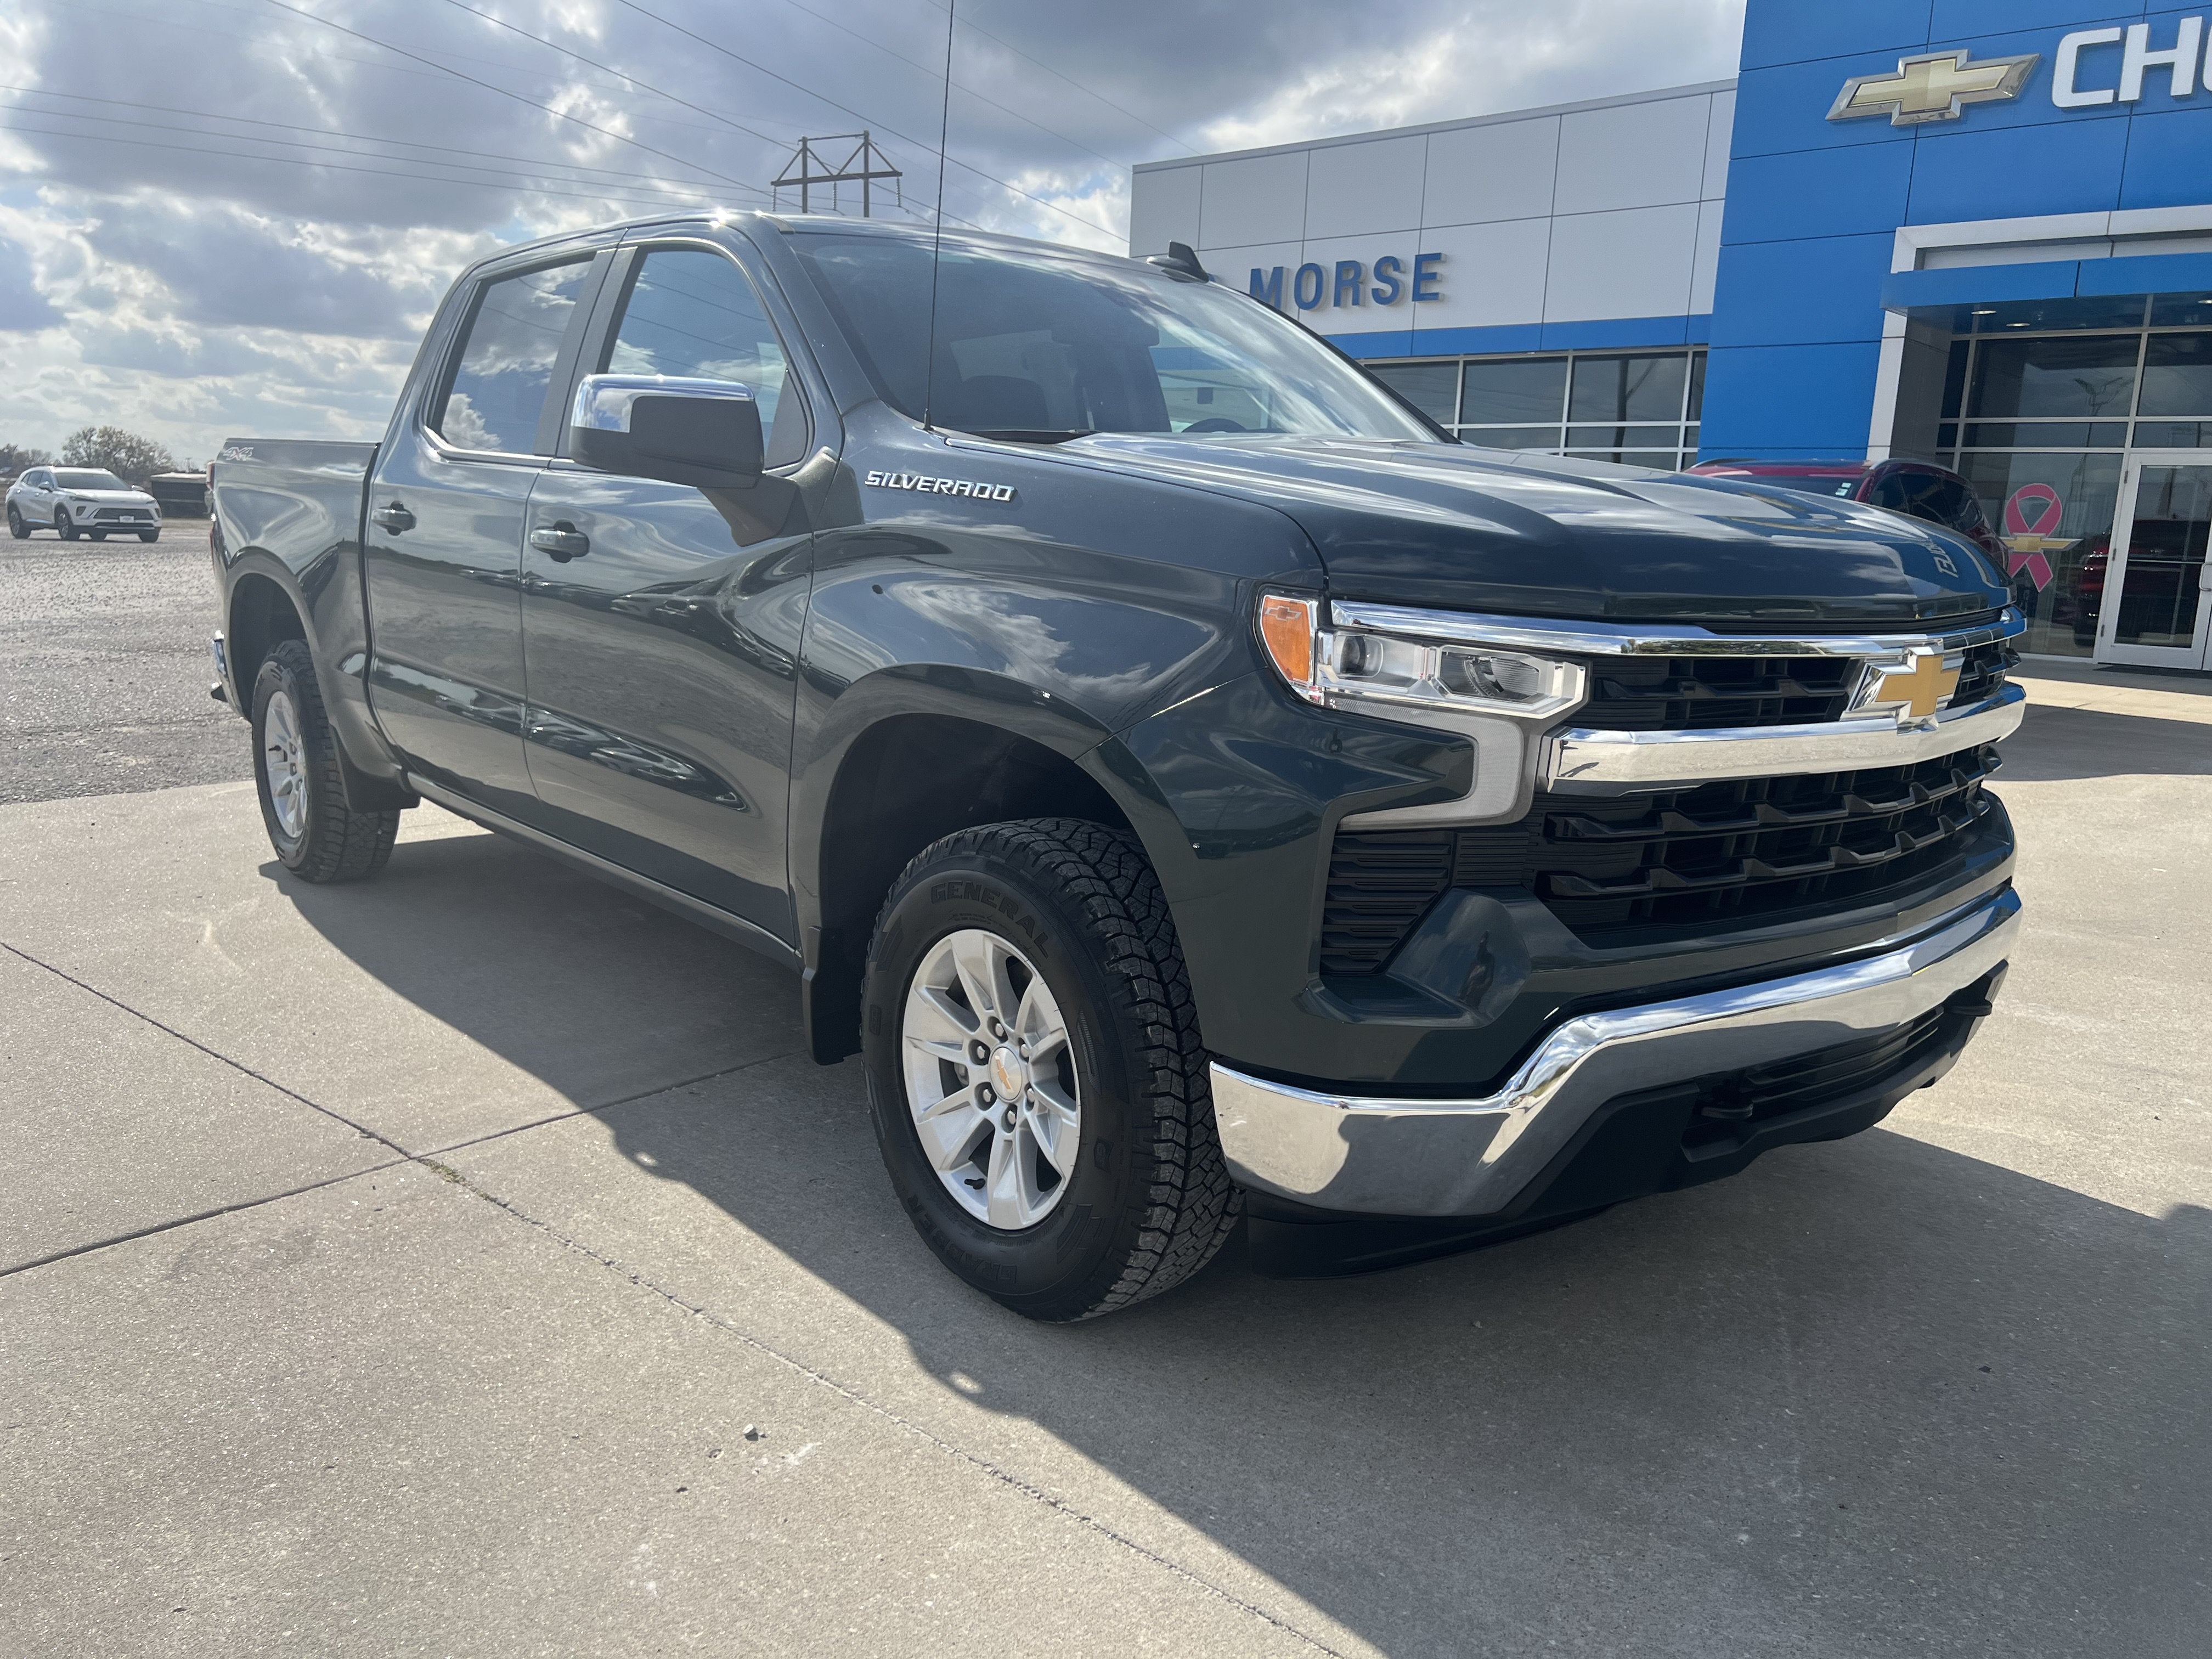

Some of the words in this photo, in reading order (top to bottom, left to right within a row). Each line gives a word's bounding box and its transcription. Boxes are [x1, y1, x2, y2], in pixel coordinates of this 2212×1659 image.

[2052, 16, 2212, 108] CH
[1249, 252, 1446, 311] MORSE
[865, 470, 1016, 503] SILVERADO
[931, 880, 1049, 960] GENERAL
[907, 1194, 1018, 1285] GRABBER
